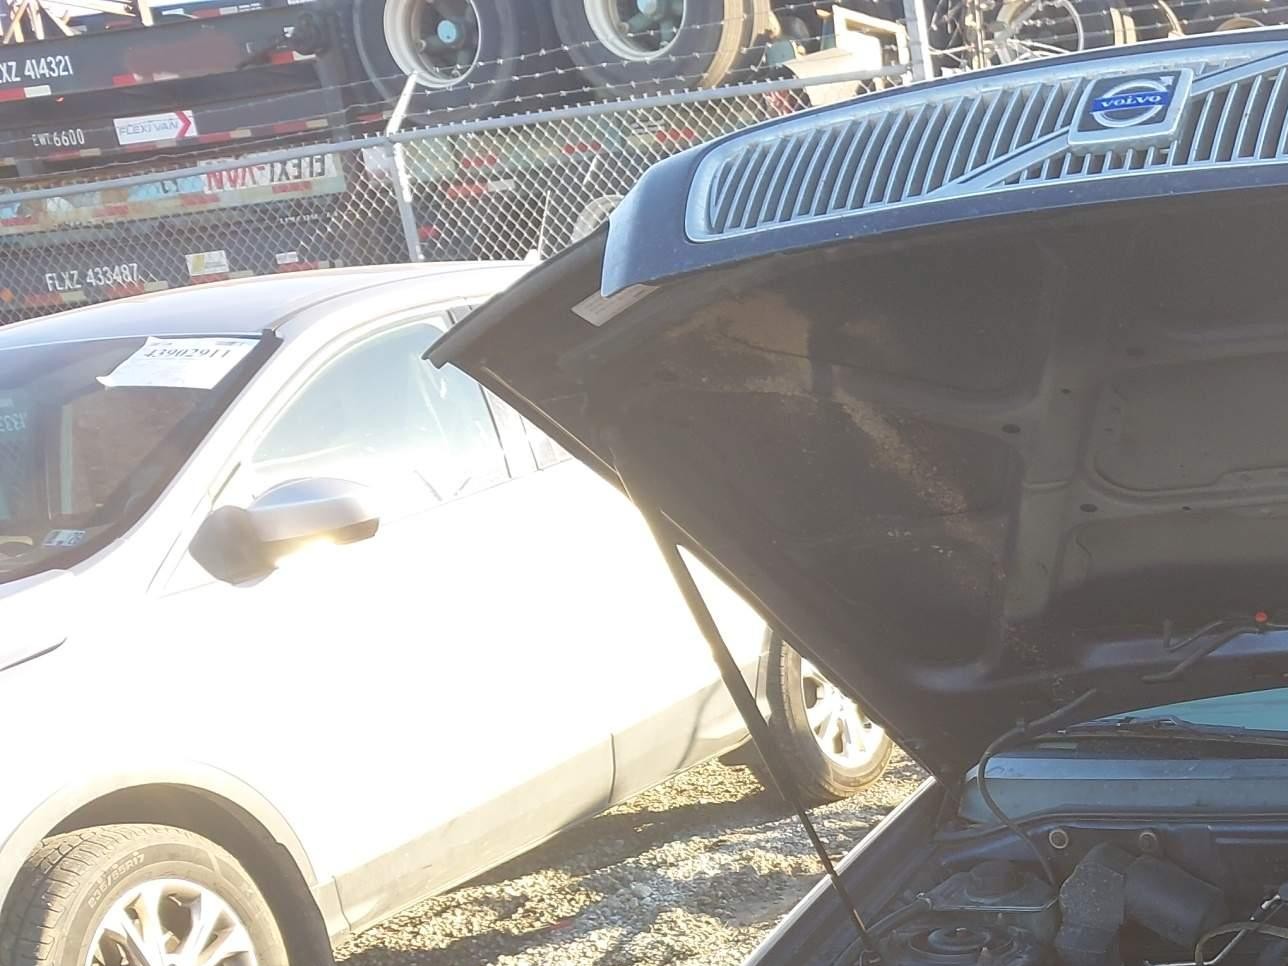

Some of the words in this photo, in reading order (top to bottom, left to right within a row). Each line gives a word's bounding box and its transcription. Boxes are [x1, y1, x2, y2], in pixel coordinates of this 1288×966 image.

[0, 61, 21, 83] XZ
[24, 55, 74, 79] 414321
[1101, 94, 1162, 107] VOLVO
[53, 128, 85, 146] 6600
[45, 270, 82, 292] FLXZ
[86, 263, 138, 286] 433487
